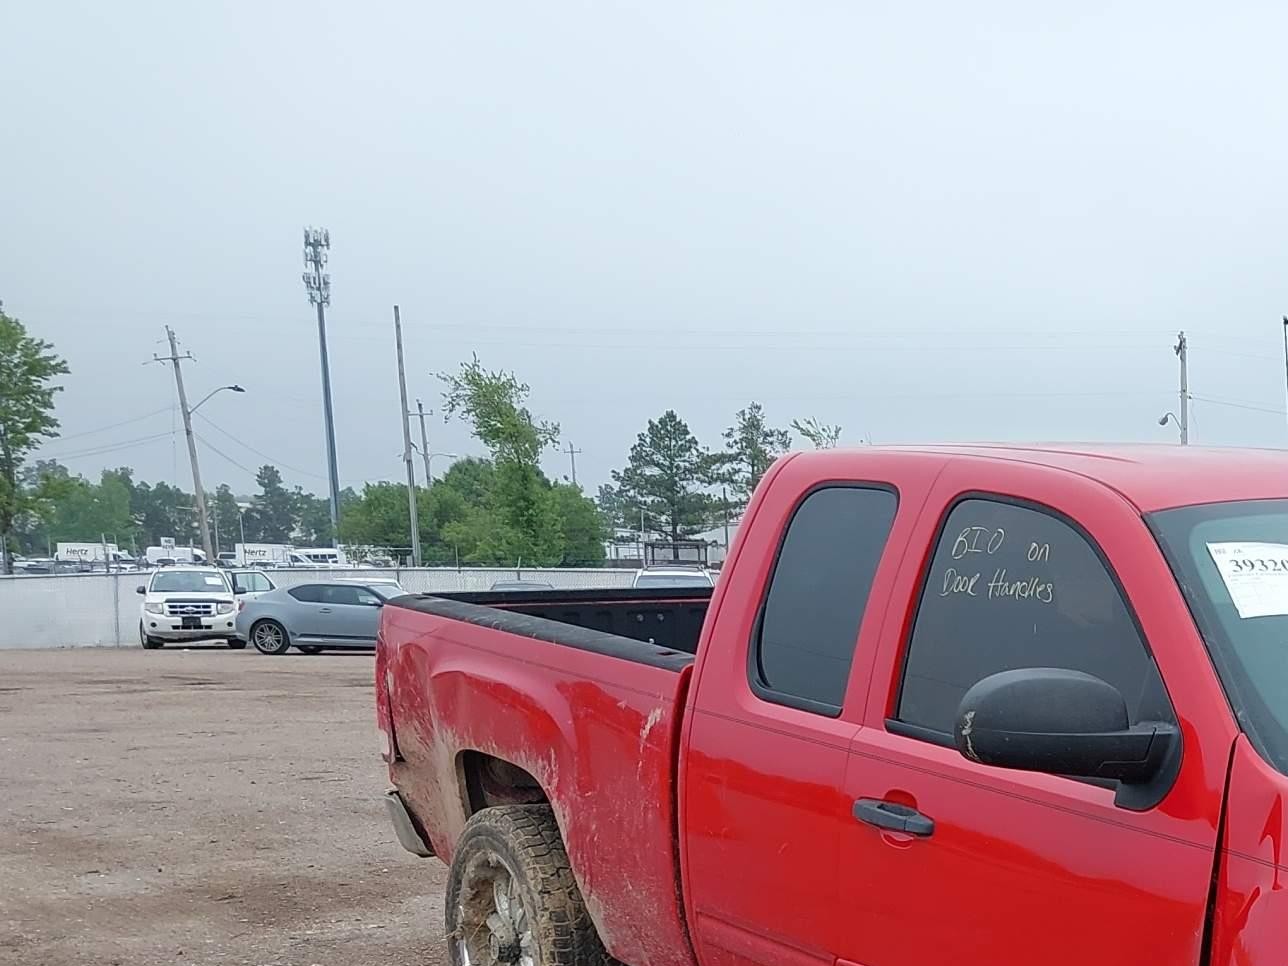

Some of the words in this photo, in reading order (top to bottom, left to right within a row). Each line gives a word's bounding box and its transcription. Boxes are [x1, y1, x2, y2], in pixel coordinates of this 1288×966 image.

[65, 547, 88, 555] Hertz
[951, 526, 1005, 560] BIO
[987, 568, 1054, 603] Handles
